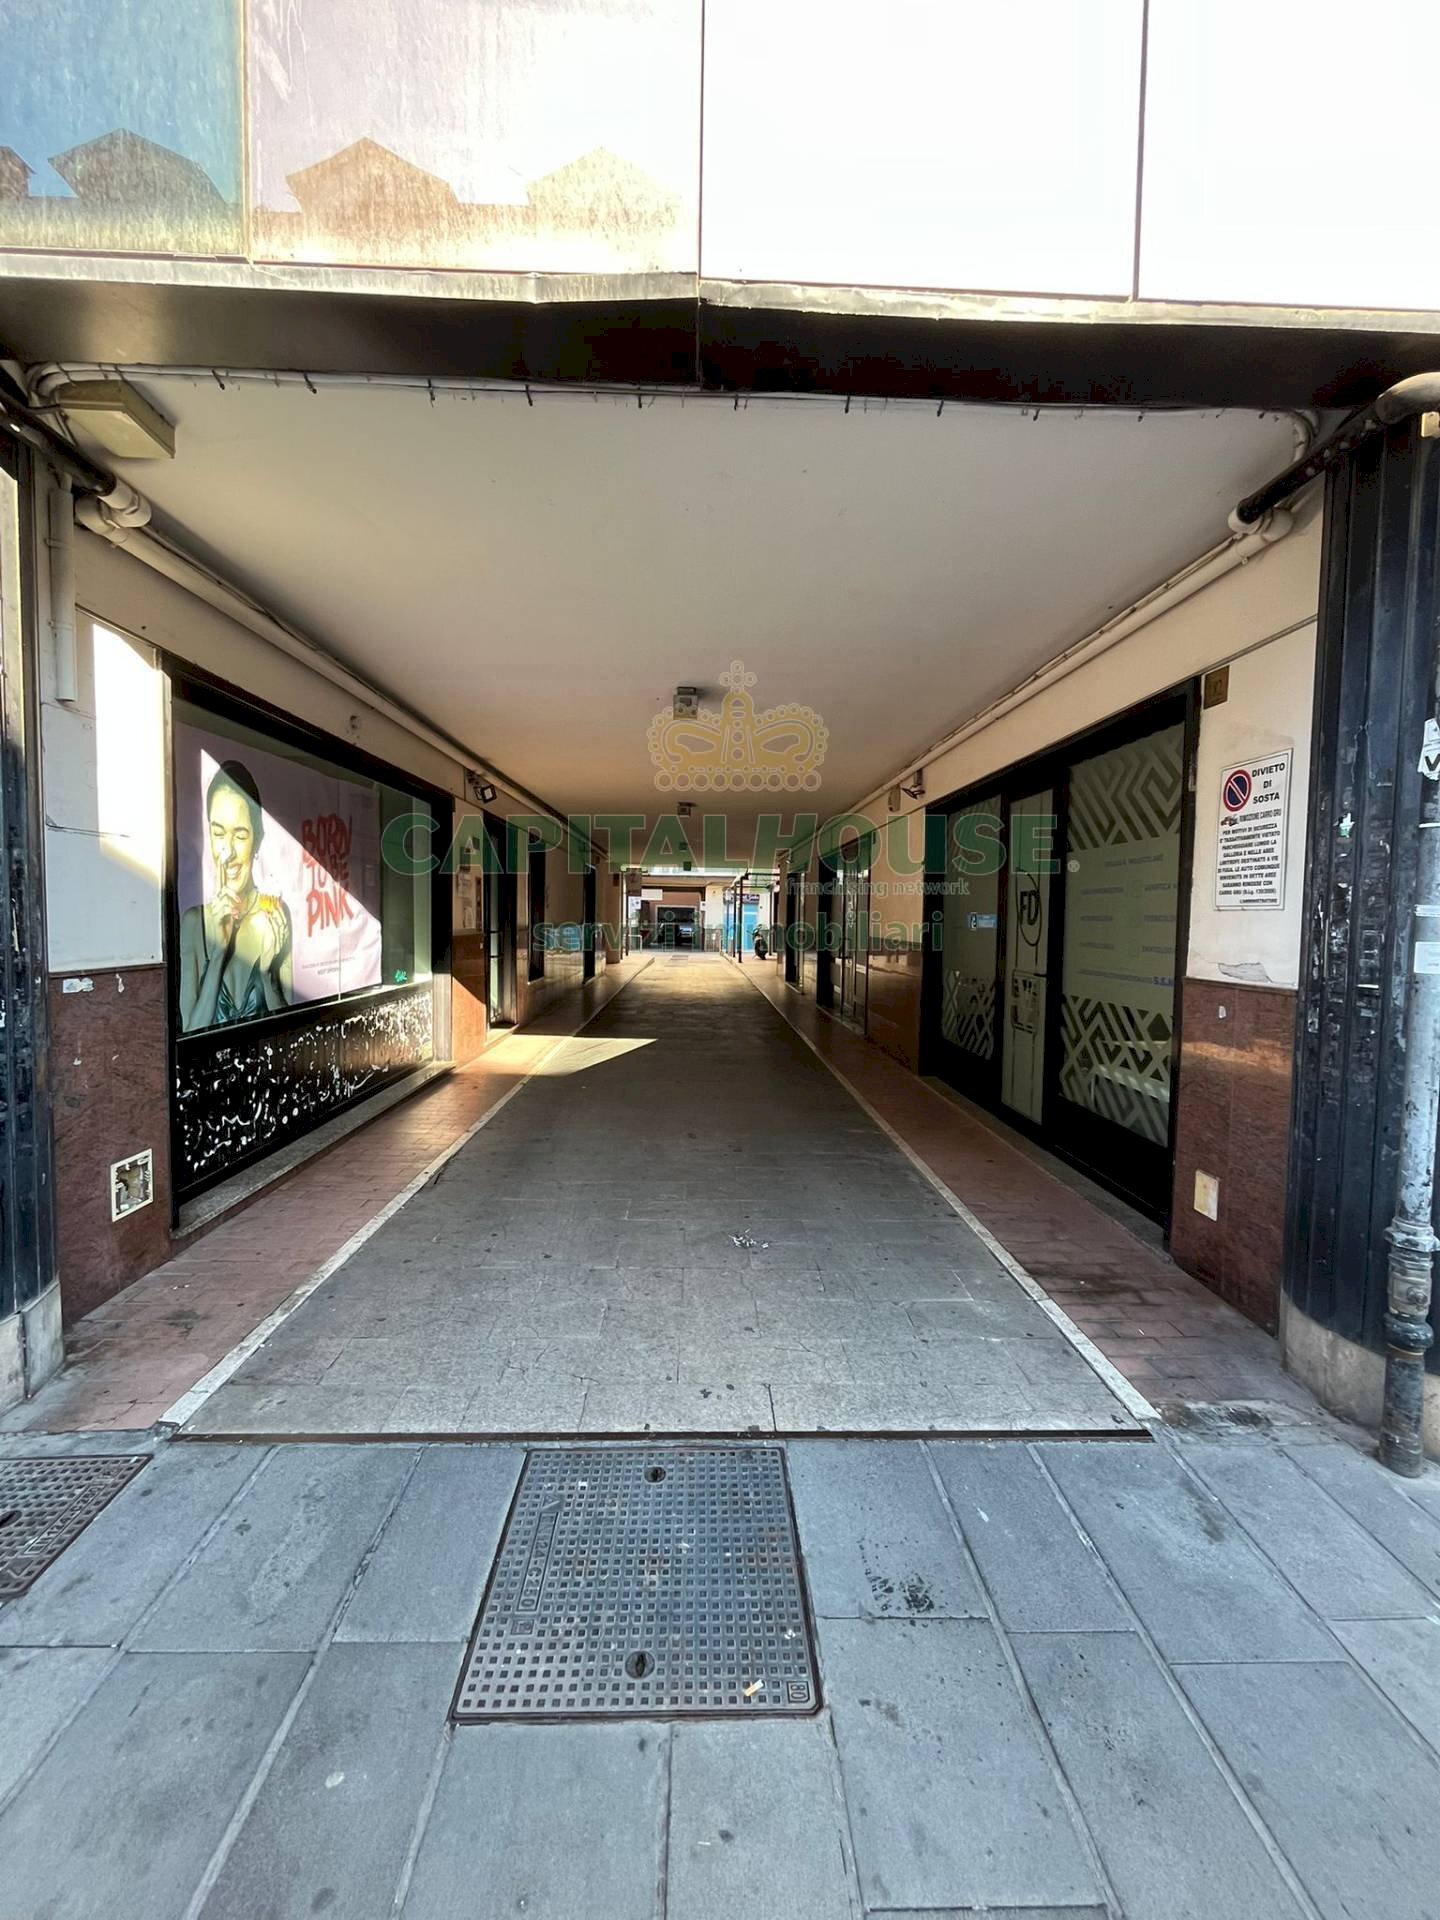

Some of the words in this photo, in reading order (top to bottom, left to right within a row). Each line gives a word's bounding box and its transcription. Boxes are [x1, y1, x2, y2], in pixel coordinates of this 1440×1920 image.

[1252, 762, 1286, 778] DIVIETO
[1263, 779, 1272, 788] DI
[1252, 792, 1280, 804] SOSTA
[306, 879, 354, 938] PINK
